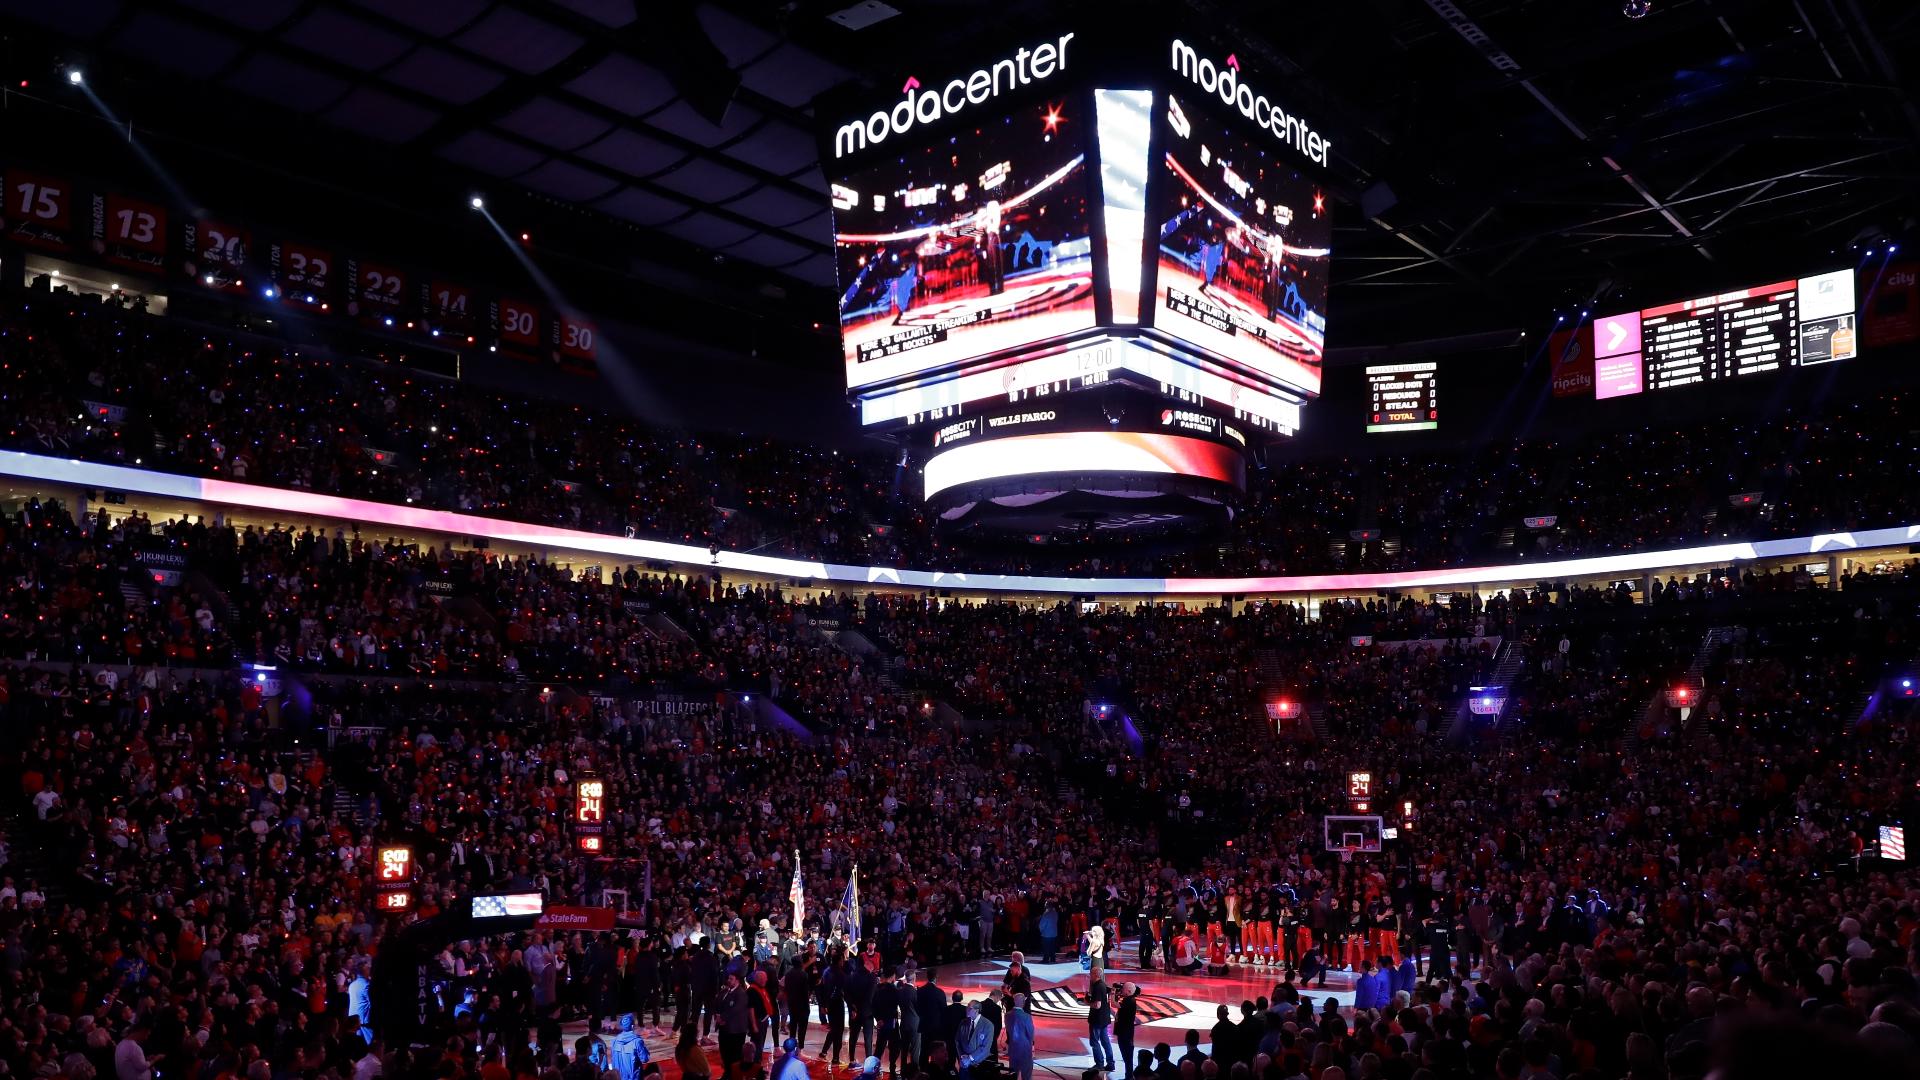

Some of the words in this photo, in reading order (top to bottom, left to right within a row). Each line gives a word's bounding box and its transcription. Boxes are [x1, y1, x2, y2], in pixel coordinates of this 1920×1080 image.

[17, 182, 61, 219] 15
[116, 209, 157, 242] 13
[1188, 296, 1196, 307] SO
[1176, 303, 1188, 314] AND
[1190, 308, 1201, 319] THE
[504, 307, 534, 335] 30
[564, 324, 592, 351] 30
[860, 340, 879, 351] WERE
[881, 336, 891, 346] SO
[894, 325, 933, 342] GALLANTLY
[870, 349, 883, 359] AND
[886, 344, 900, 354] THE
[1373, 383, 1379, 391] 0
[1429, 379, 1435, 387] 0
[1553, 375, 1591, 389] ripcity
[1373, 393, 1379, 401] 0
[1430, 389, 1435, 398] 0
[1373, 403, 1379, 411] 0
[1385, 401, 1418, 410] STEALS
[989, 414, 1020, 427] WELLS
[1021, 411, 1056, 423] FARGO
[147, 552, 165, 561] KUNI
[166, 554, 185, 563] LEXU
[1352, 782, 1368, 795] 24
[580, 798, 599, 821] 24
[383, 863, 403, 878] 24
[388, 894, 407, 907] 1:30
